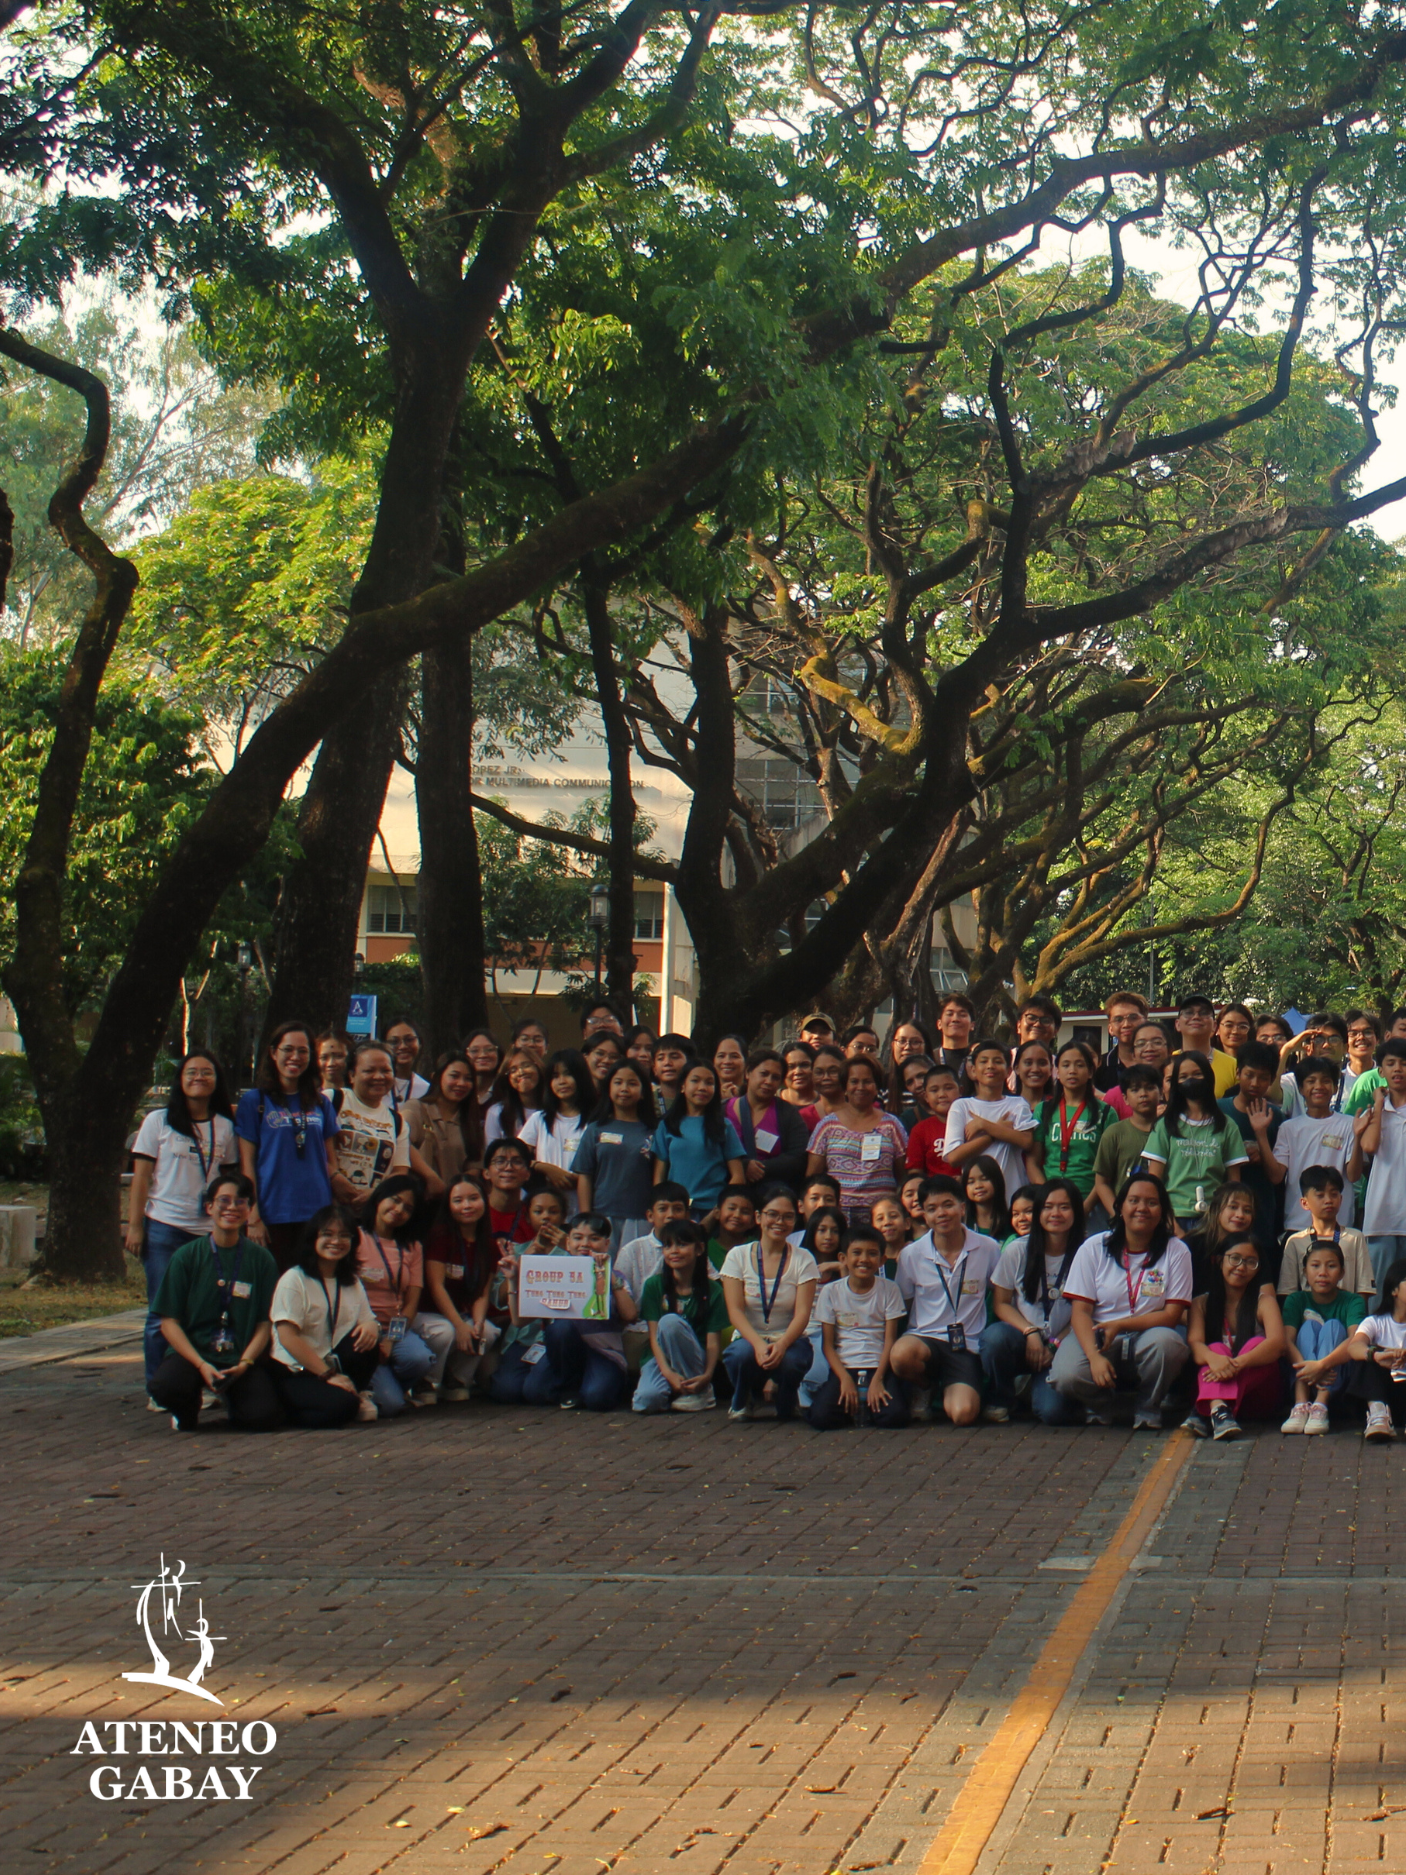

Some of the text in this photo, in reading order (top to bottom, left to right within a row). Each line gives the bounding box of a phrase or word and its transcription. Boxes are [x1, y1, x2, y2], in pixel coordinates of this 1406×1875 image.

[471, 765, 501, 775] OPEZ
[486, 777, 550, 788] MULTIMEDIA
[553, 778, 644, 789] COMMUNICON
[526, 1270, 584, 1284] GROUP 5A
